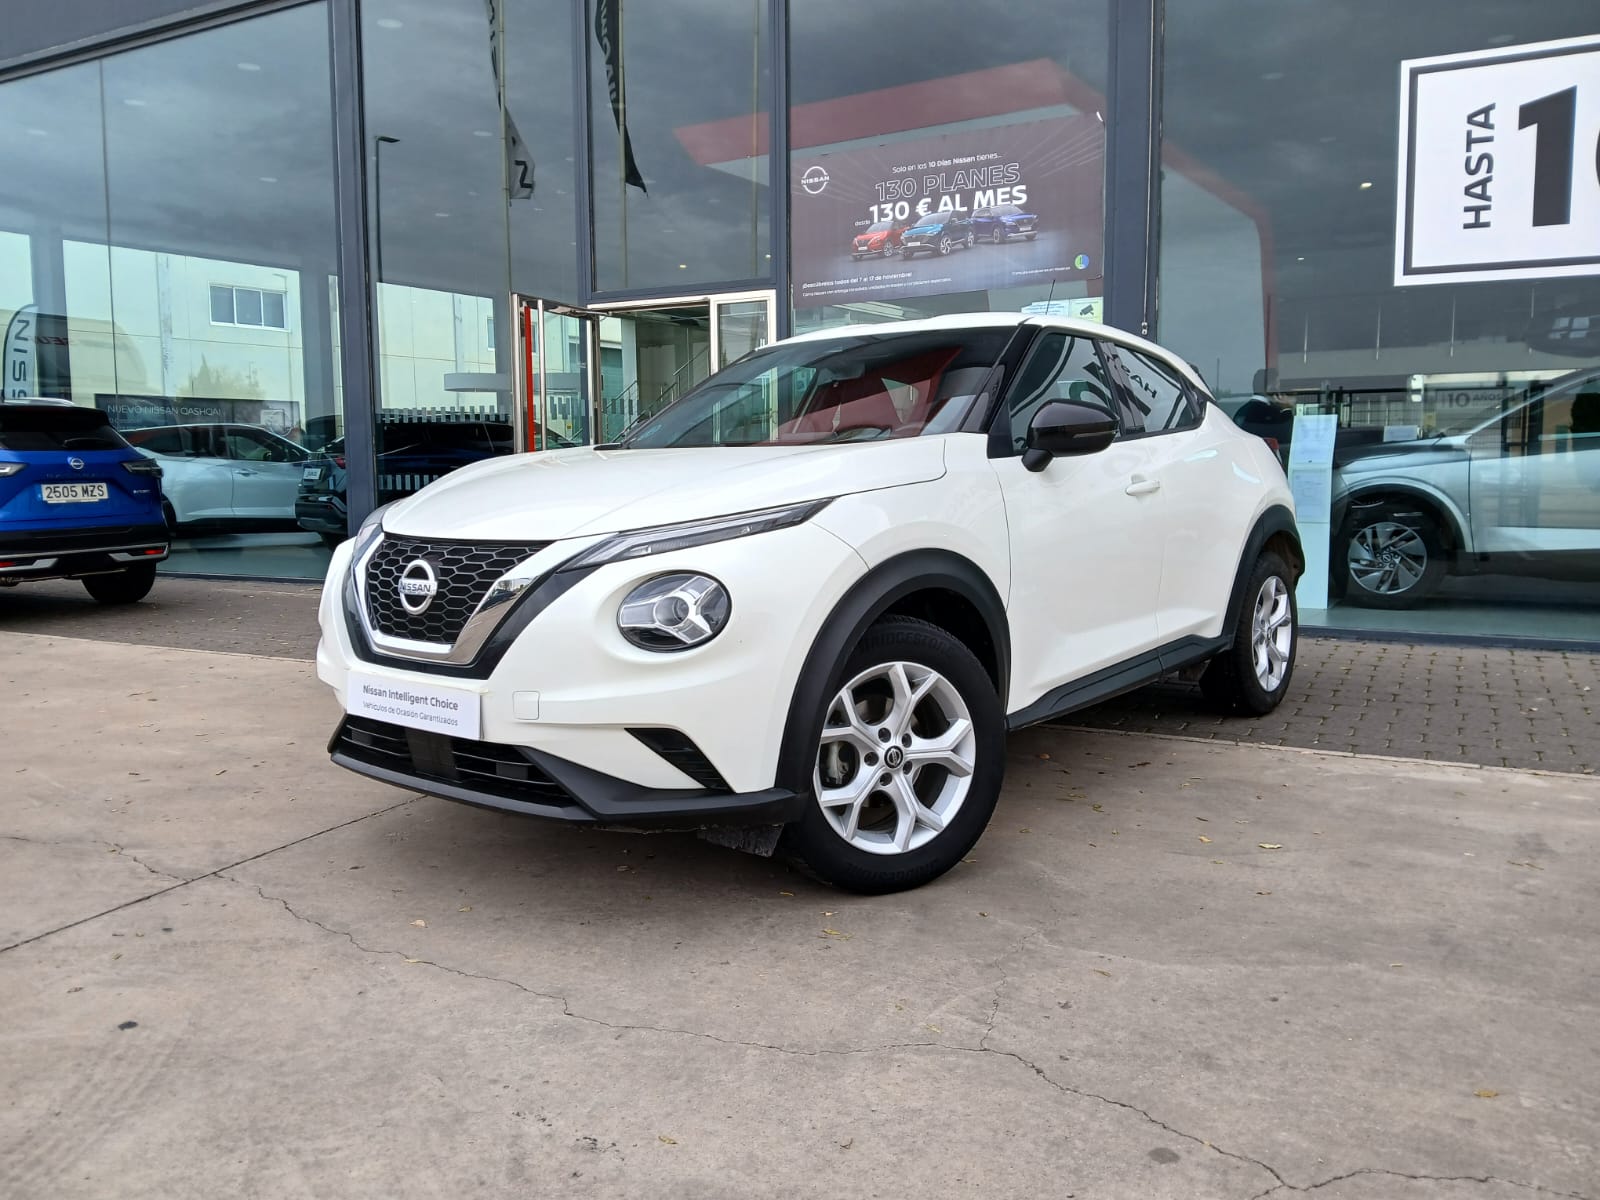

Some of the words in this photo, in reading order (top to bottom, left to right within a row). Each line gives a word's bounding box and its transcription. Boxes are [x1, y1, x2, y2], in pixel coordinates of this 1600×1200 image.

[952, 156, 976, 165] Nissan
[1518, 84, 1600, 227] 1
[1463, 102, 1496, 230] HASTA
[801, 176, 830, 185] NISSAN
[875, 177, 917, 201] 130
[923, 162, 1021, 195] PLANES
[869, 200, 910, 224] 130
[915, 197, 932, 217] €
[937, 193, 968, 213] AL
[973, 184, 1028, 209] MES
[108, 404, 144, 414] NUEVO
[144, 405, 178, 415] NISSAN
[45, 486, 78, 499] 2505
[81, 484, 105, 498] MZS
[399, 582, 431, 593] NISSAN
[363, 684, 387, 698] Nissan
[388, 689, 429, 706] Intelligent
[430, 696, 459, 711] Choice
[388, 706, 395, 714] de
[419, 712, 459, 726] Garantizados
